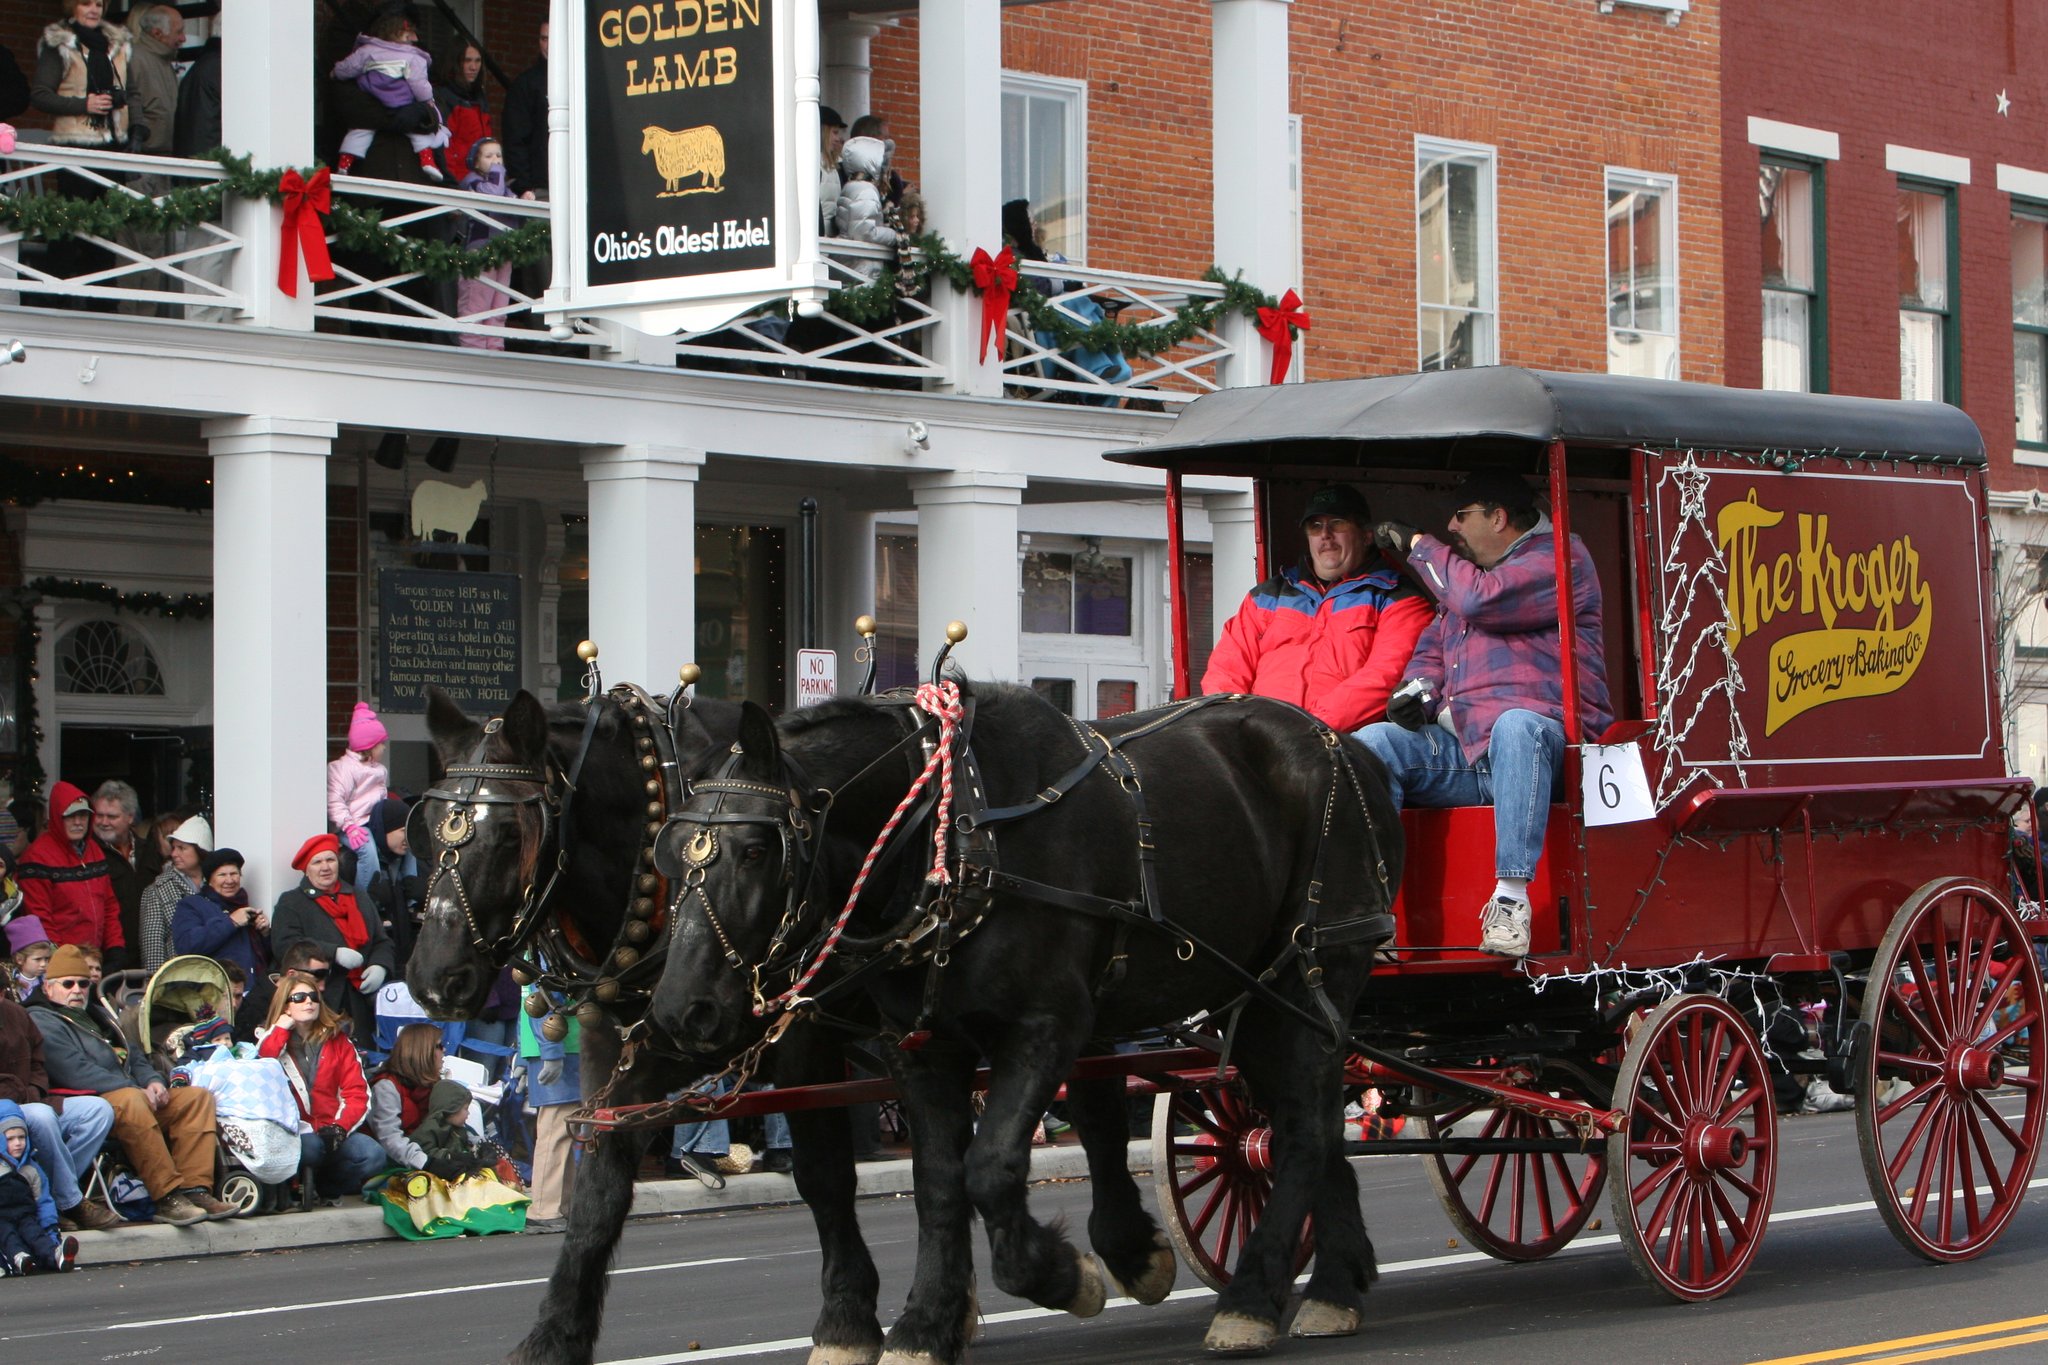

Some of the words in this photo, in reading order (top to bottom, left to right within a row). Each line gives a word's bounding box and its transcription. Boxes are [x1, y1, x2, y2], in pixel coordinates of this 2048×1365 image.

[600, 0, 760, 47] GOLDEN
[626, 47, 738, 96] LAMB
[594, 232, 651, 264] Ohio's
[655, 221, 719, 256] Oldest
[723, 217, 770, 250] Hotel
[1717, 487, 1796, 656] The
[1797, 513, 1931, 632] Kroger
[394, 583, 428, 596] Famous
[458, 586, 478, 598] 1815
[480, 590, 490, 599] as
[493, 588, 509, 600] the
[388, 613, 408, 626] And
[414, 615, 431, 627] the
[436, 616, 467, 628] oldest
[474, 617, 489, 630] Inn
[496, 619, 515, 631] still
[388, 630, 435, 644] operating
[437, 633, 448, 641] as
[449, 634, 456, 642] a
[458, 631, 481, 643] hotel
[482, 633, 492, 644] in
[389, 642, 412, 654] Here
[464, 645, 492, 659] Henry
[412, 656, 447, 669] Dickens
[449, 659, 466, 670] and
[467, 661, 491, 672] many
[492, 660, 515, 672] other
[810, 659, 824, 675] NO
[1776, 650, 1846, 702] Grocery
[1855, 636, 1905, 679] Baking
[389, 671, 421, 682] famous
[424, 673, 442, 683] men
[444, 672, 467, 684] have
[393, 684, 417, 697] NOW
[478, 688, 511, 701] HOTEL
[801, 678, 834, 695] PARKING
[1599, 764, 1621, 809] 6
